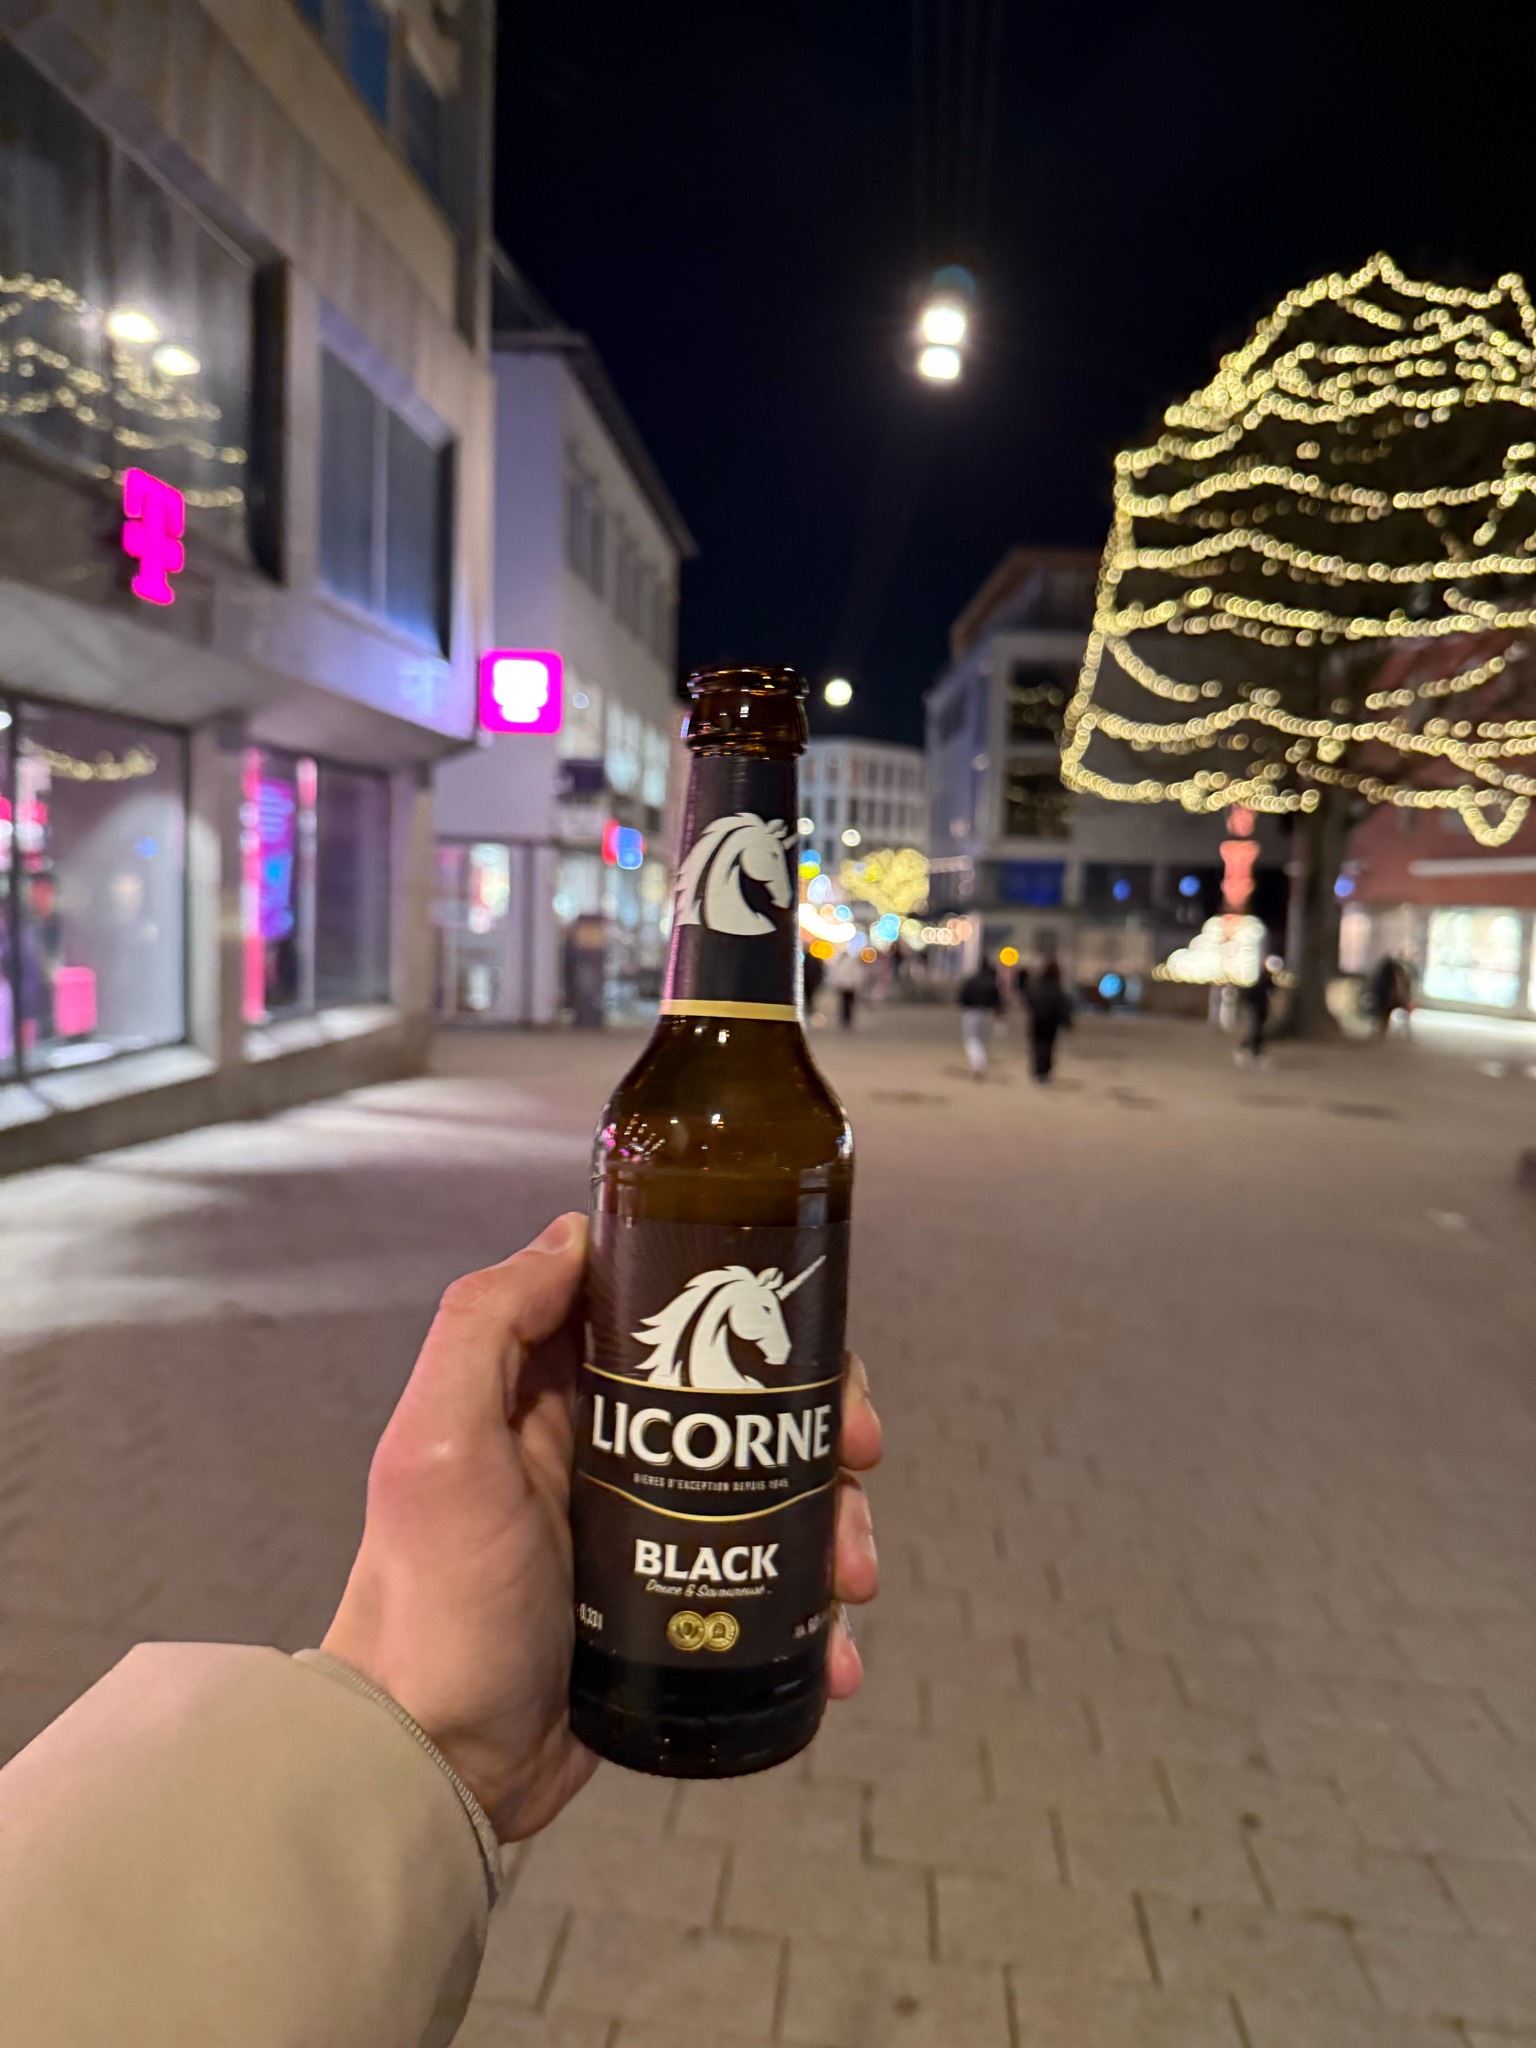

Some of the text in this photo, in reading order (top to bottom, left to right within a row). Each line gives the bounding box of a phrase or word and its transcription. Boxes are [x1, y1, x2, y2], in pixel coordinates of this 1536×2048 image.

[591, 1394, 832, 1471] LICORNE
[633, 1538, 780, 1582] BLACK
[645, 1578, 683, 1596] Douce
[684, 1583, 696, 1597] &
